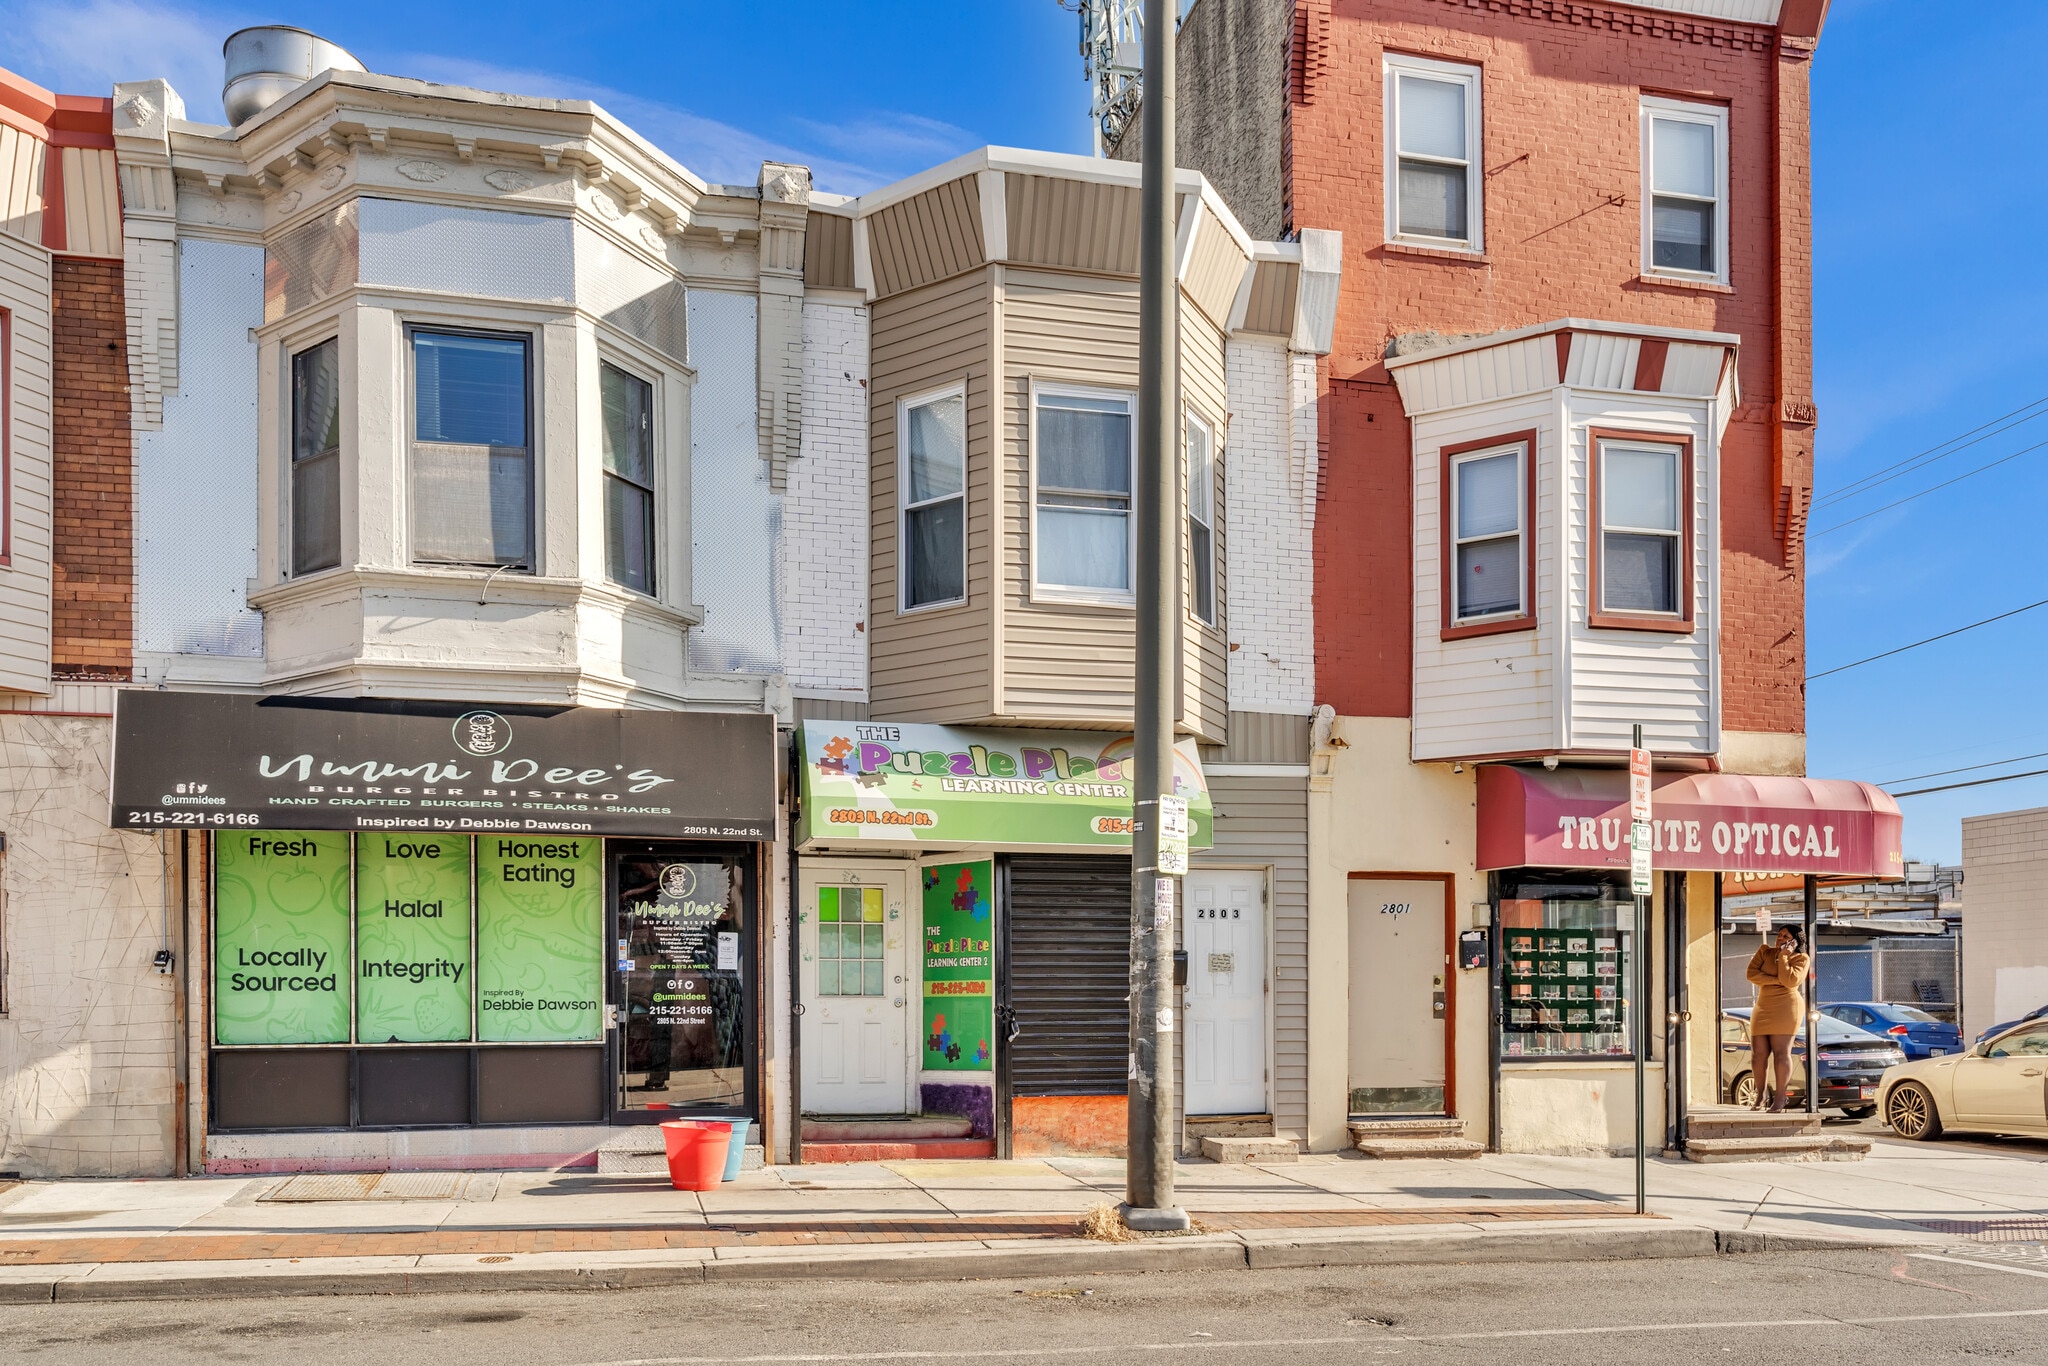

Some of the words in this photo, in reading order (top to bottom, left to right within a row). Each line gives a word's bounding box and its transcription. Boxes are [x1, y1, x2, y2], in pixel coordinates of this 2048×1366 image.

[856, 726, 900, 741] THE
[857, 740, 1017, 779] Puzzle
[258, 754, 472, 784] Ummi
[491, 758, 675, 794] Dee's
[308, 786, 464, 796] BURGER
[483, 788, 620, 801] BISTRO
[941, 778, 1048, 796] LEARNING
[1053, 780, 1129, 798] CENTER
[161, 794, 226, 806] @ummidees
[268, 797, 319, 806] HAND
[328, 798, 411, 807] CRAFTED
[420, 800, 503, 808] BURGERS
[522, 802, 588, 812] STEAKS
[606, 805, 672, 814] SHAKES
[128, 812, 260, 825] 215-221-6166
[356, 816, 430, 828] Inspired
[434, 818, 456, 830] by
[460, 818, 520, 830] Debbie
[524, 819, 592, 831] Dawson
[830, 809, 865, 824] 2803
[867, 810, 881, 824] N.
[882, 810, 914, 824] 22nd
[916, 812, 933, 826] St.
[1098, 817, 1134, 832] 215-2
[684, 826, 708, 834] 2805
[722, 827, 747, 836] 22nd
[749, 828, 763, 836] St.
[1558, 815, 1701, 854] TRU-ITE
[1711, 822, 1840, 858] OPTICAL
[1632, 828, 1637, 846] 2
[249, 838, 318, 857] Fresh
[385, 840, 441, 858] Love
[498, 840, 580, 859] Honest
[502, 864, 576, 888] Eating
[384, 900, 443, 918] Halal
[634, 900, 682, 918] Ummi
[684, 900, 726, 919] Dee's
[1198, 909, 1240, 918] 2803
[1380, 904, 1410, 914] 2801
[927, 926, 940, 936] THE
[926, 938, 959, 954] Puzzle
[961, 938, 989, 953] Place
[238, 948, 328, 972] Locally
[928, 957, 958, 968] LEARNING
[960, 957, 981, 966] CENTER
[984, 957, 988, 966] 2
[362, 958, 465, 984] Integrity
[231, 973, 336, 992] Sourced
[931, 982, 986, 994] 215-225-KIDS
[483, 989, 512, 998] Inspired
[514, 989, 524, 998] By
[652, 992, 706, 1002] @ummidees
[483, 998, 534, 1012] Debbie
[537, 998, 598, 1011] Dawson
[649, 1006, 712, 1015] 215-221-6166
